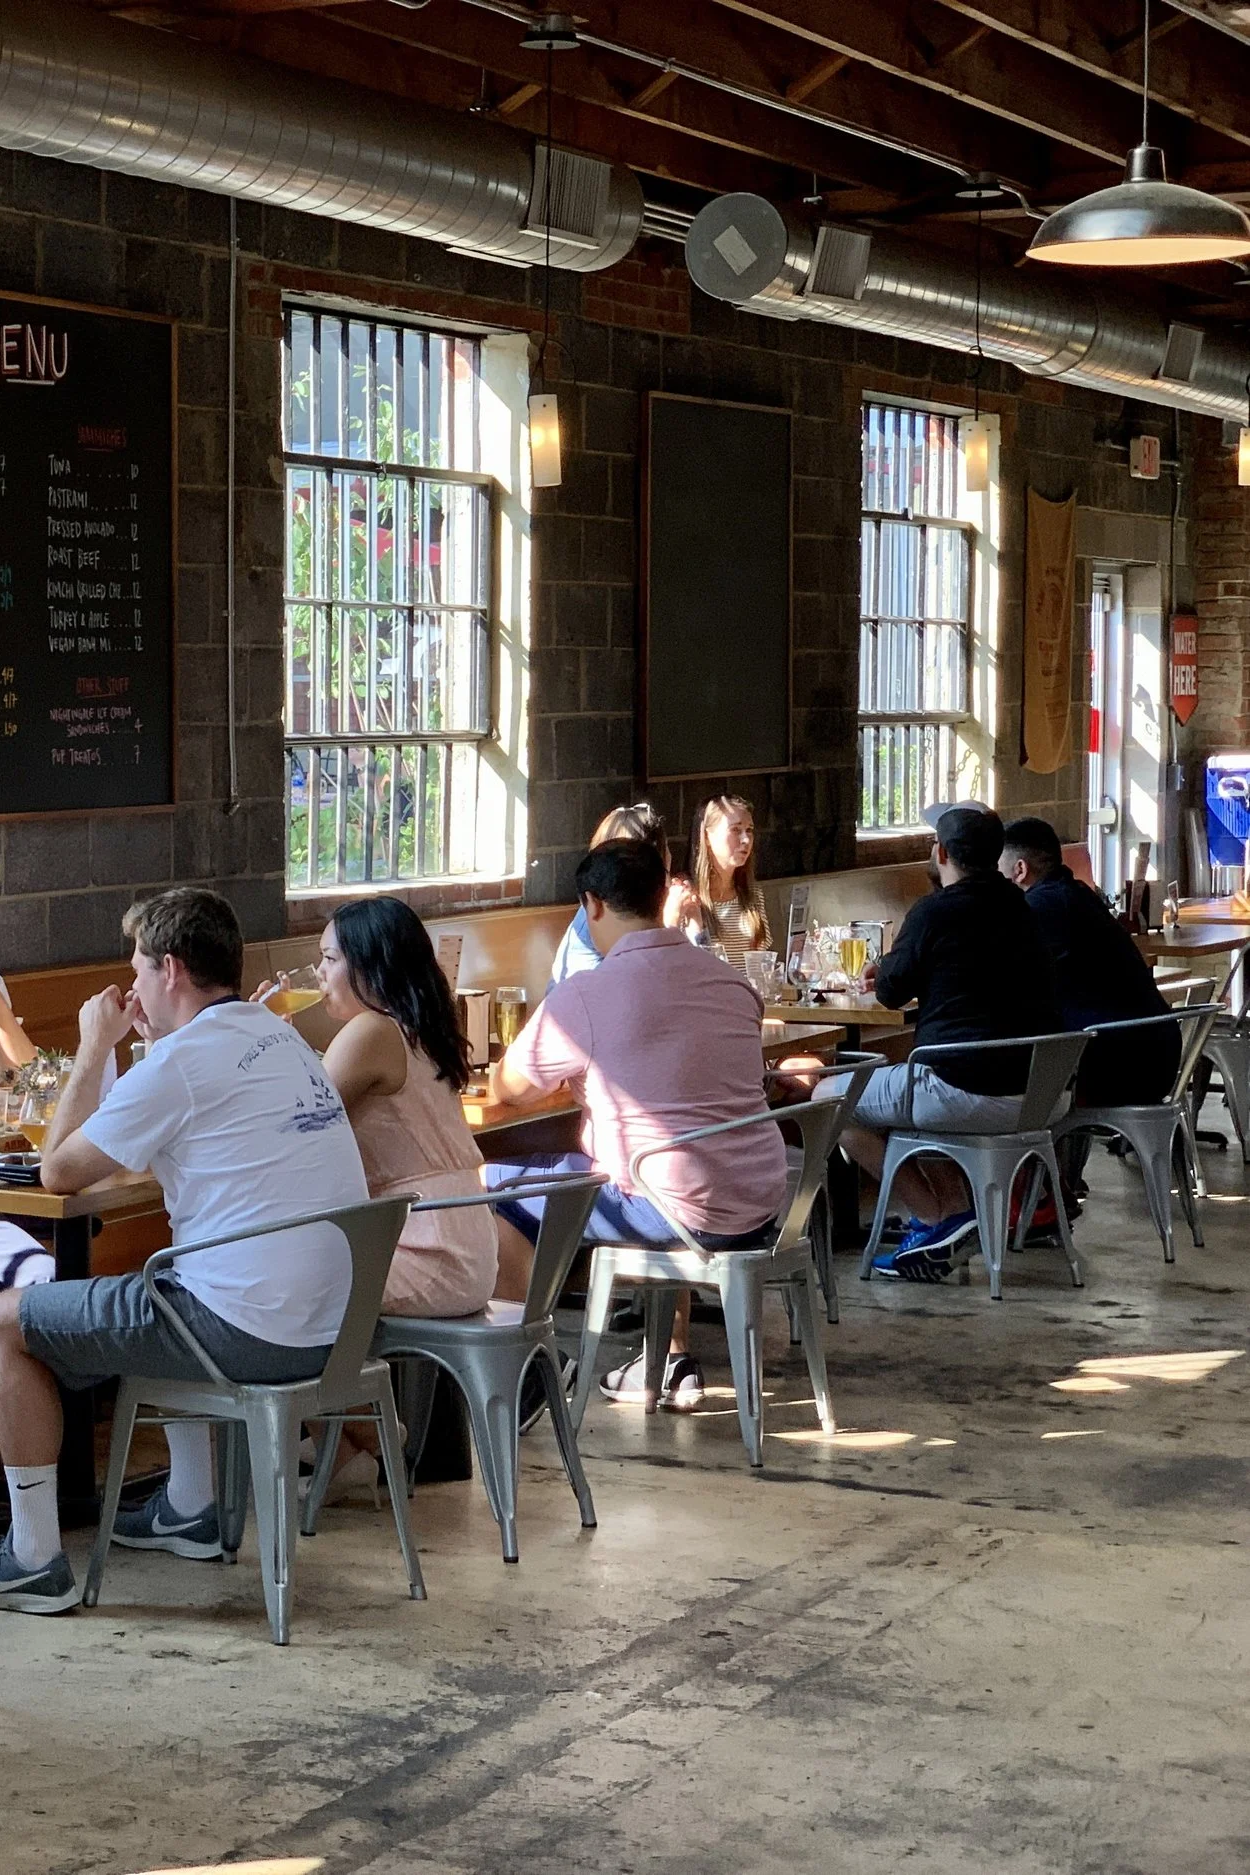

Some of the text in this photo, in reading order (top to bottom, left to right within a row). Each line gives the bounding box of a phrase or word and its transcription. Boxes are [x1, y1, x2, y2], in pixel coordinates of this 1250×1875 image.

[0, 454, 6, 472] 7
[47, 454, 140, 480] TUNA 10
[47, 486, 88, 509] PASTRAMI
[47, 516, 139, 542] PRESSED AVOCADO 12
[47, 544, 142, 571] ROAST BEEF 12
[77, 579, 106, 603] GRILLED
[133, 581, 142, 600] 12
[48, 606, 142, 630] TURKEY & APPLE 12
[48, 634, 75, 653] VEGAN
[134, 635, 144, 652] 12
[1174, 631, 1196, 655] WATER
[106, 676, 130, 694] STUFF
[1174, 664, 1197, 696] HERE
[97, 706, 107, 719] ICE
[110, 705, 132, 720] CREAM
[66, 718, 144, 738] SANDWICHES 4
[133, 744, 142, 764] 7
